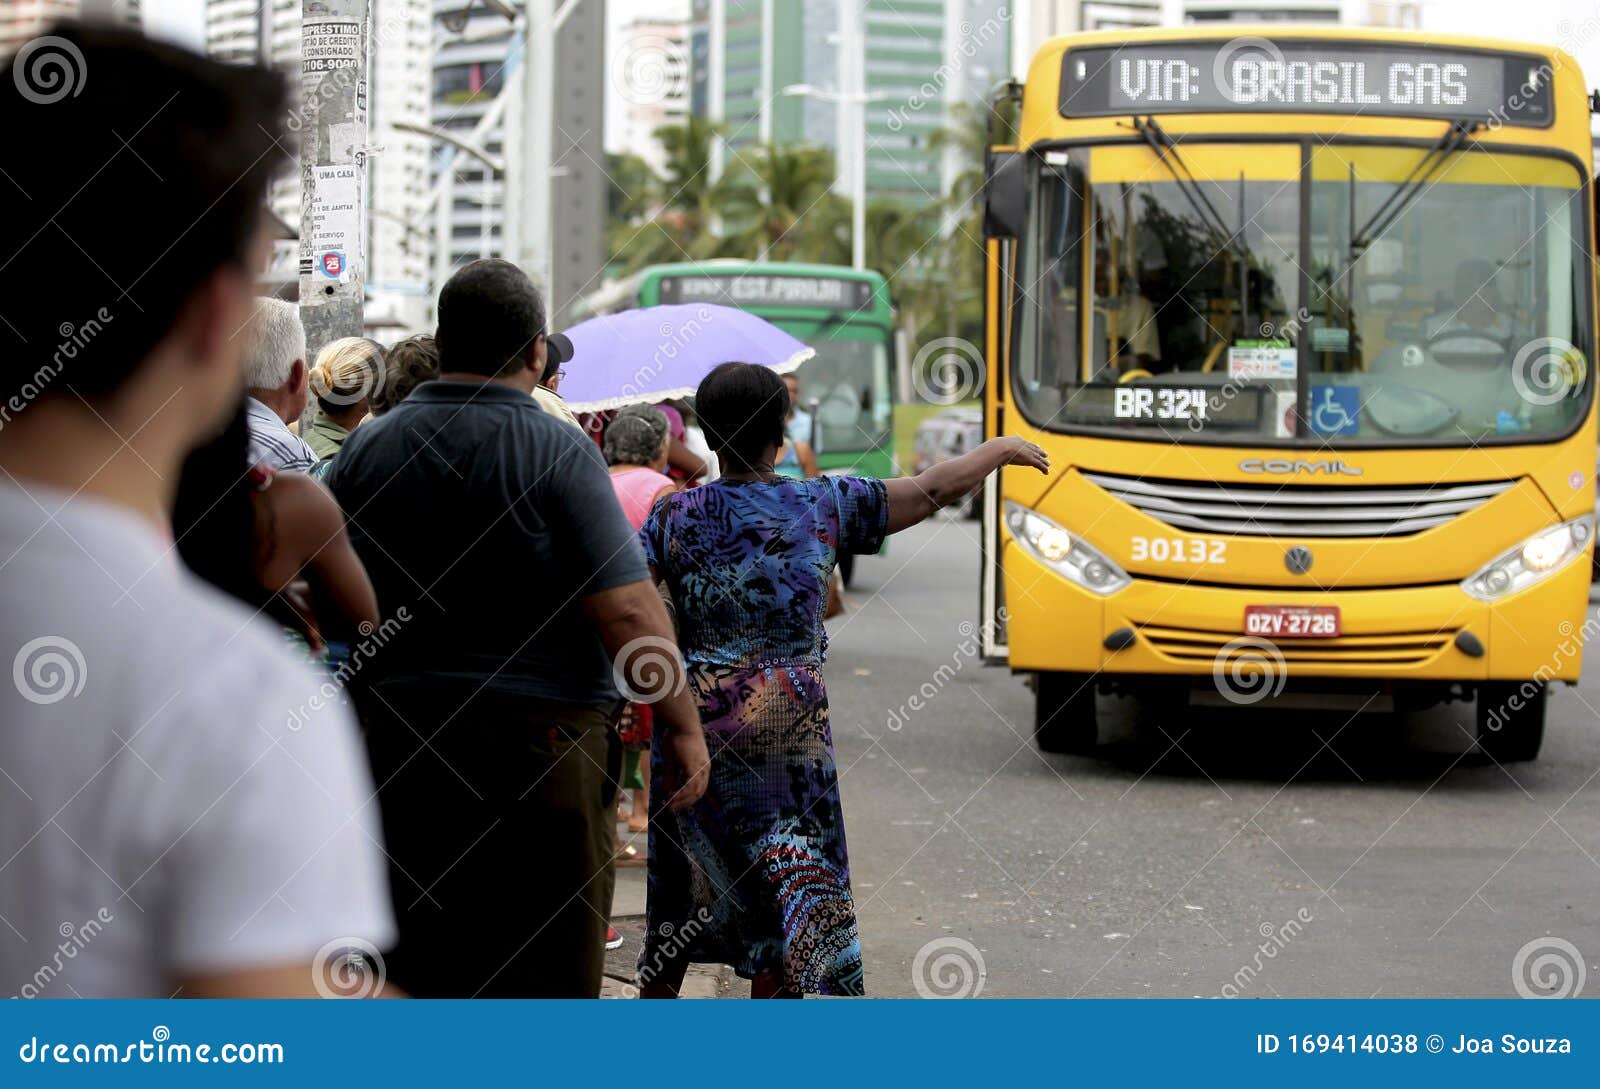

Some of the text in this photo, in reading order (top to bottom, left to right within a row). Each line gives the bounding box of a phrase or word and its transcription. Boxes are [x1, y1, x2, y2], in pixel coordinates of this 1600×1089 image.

[308, 47, 353, 56] CONSIGNADO
[1119, 59, 1468, 105] VIA: BRASIL GAS
[319, 171, 355, 180] UMA CASA
[326, 260, 340, 270] 25
[1114, 388, 1208, 419] BR 324
[1239, 458, 1364, 477] COMIL
[1131, 536, 1228, 563] 30132
